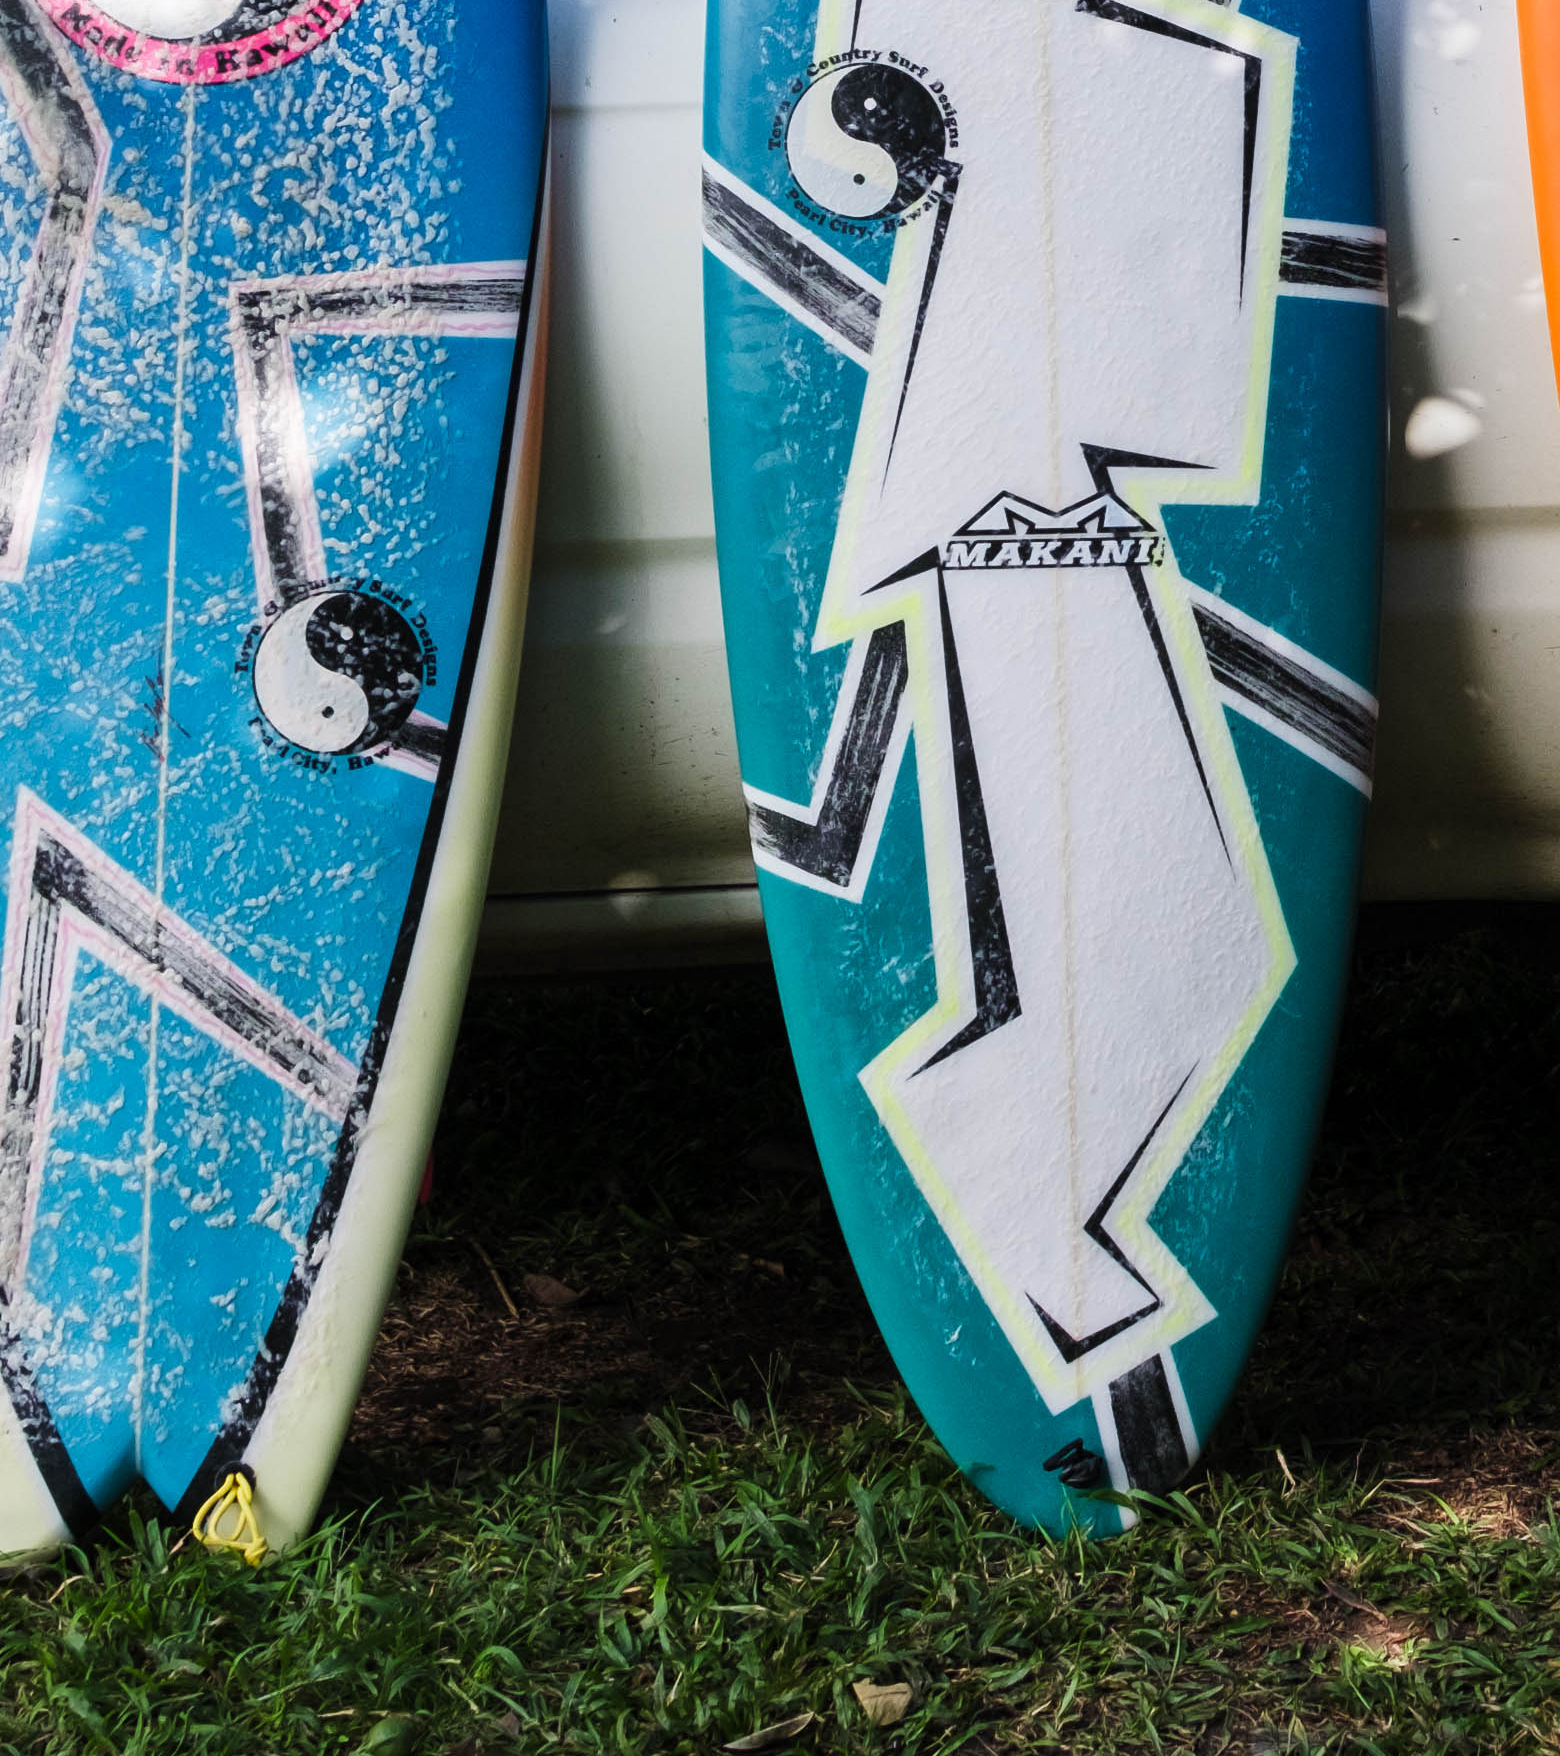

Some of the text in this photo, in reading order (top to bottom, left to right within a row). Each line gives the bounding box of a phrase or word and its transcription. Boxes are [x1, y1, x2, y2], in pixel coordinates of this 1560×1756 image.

[806, 48, 883, 77] Country
[888, 50, 930, 78] Surf
[929, 80, 959, 148] Designs
[786, 187, 827, 226] Pearl
[942, 537, 1158, 569] MAKANI
